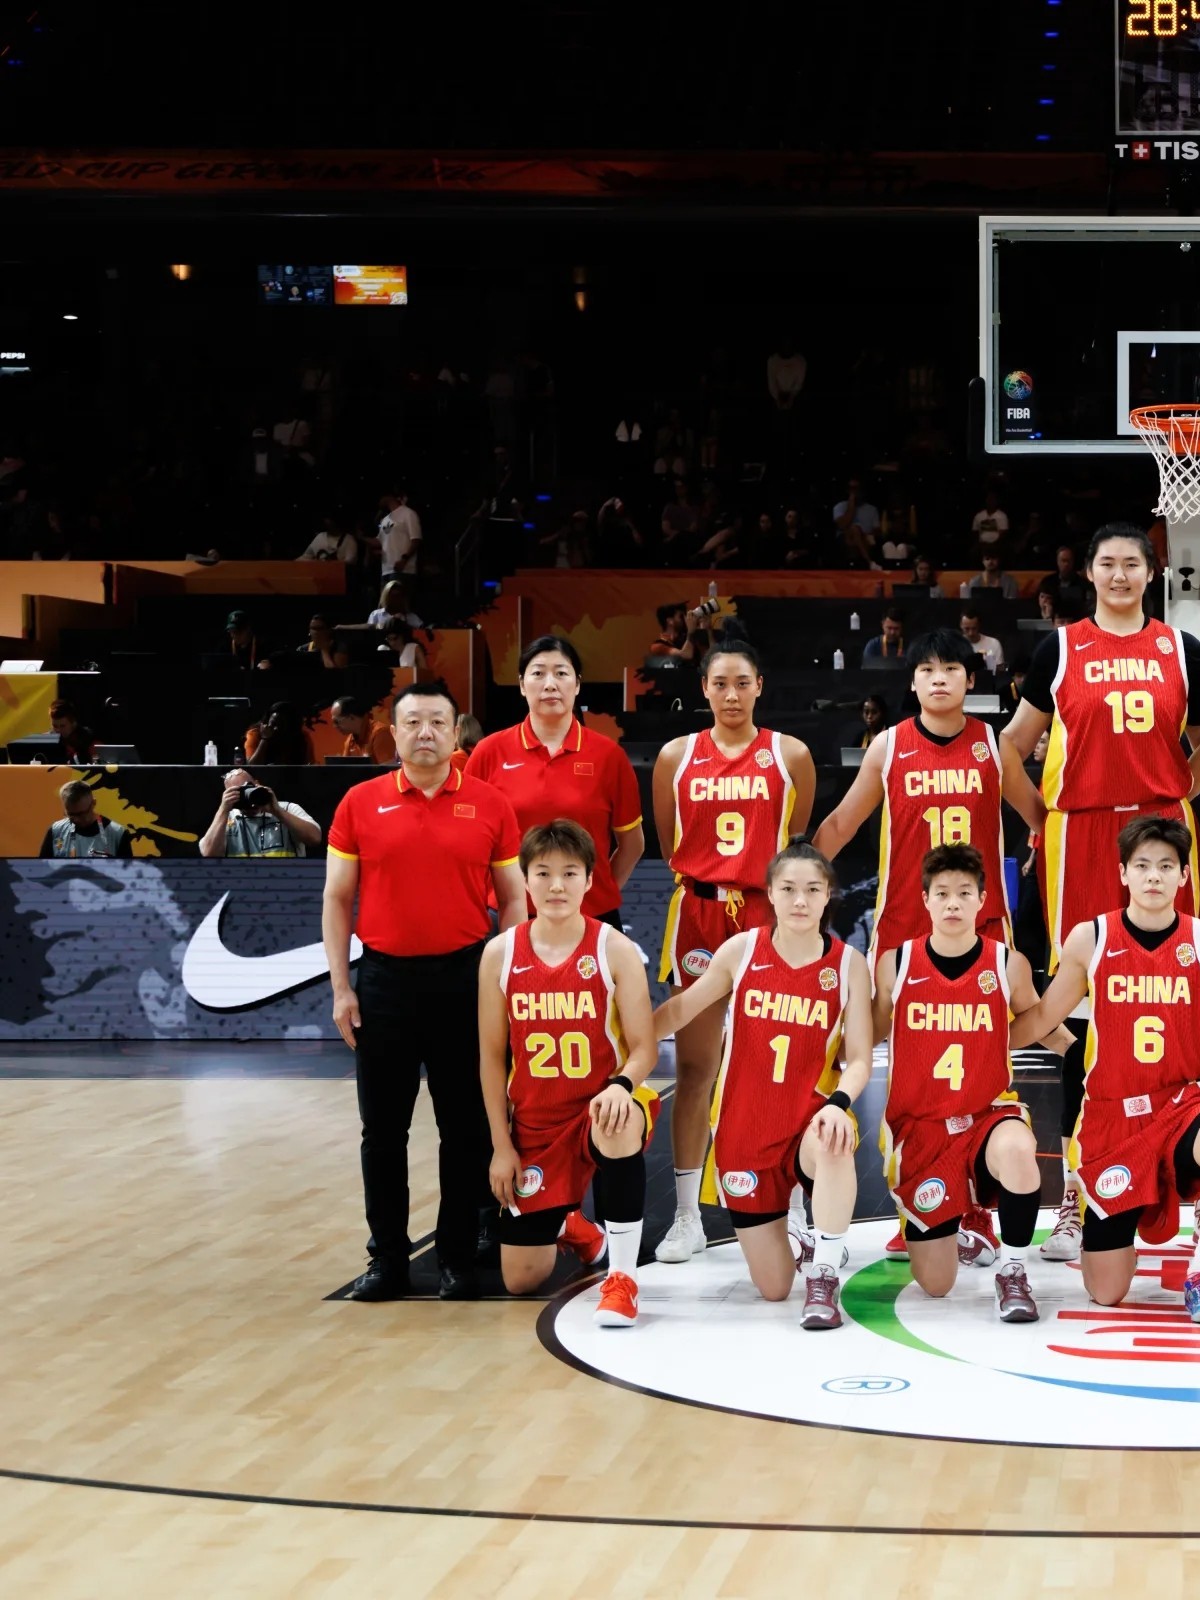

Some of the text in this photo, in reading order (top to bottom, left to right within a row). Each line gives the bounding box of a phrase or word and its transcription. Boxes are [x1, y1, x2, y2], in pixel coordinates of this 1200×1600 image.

[1007, 408, 1030, 419] FIBA
[1084, 658, 1165, 684] CHINA
[1103, 690, 1155, 734] 19
[690, 775, 770, 802] CHINA
[904, 768, 984, 797] CHINA
[716, 811, 745, 856] 9
[922, 805, 971, 850] 18
[1107, 974, 1192, 1005] CHINA
[511, 990, 597, 1021] CHINA
[745, 988, 829, 1030] CHINA
[907, 1002, 994, 1032] CHINA
[525, 1031, 592, 1079] 20
[1133, 1015, 1165, 1064] 6
[769, 1034, 791, 1084] 1
[933, 1043, 965, 1091] 4
[727, 1175, 752, 1188] 伊利
[918, 1184, 941, 1206] 伊利
[1101, 1173, 1125, 1190] 伊利
